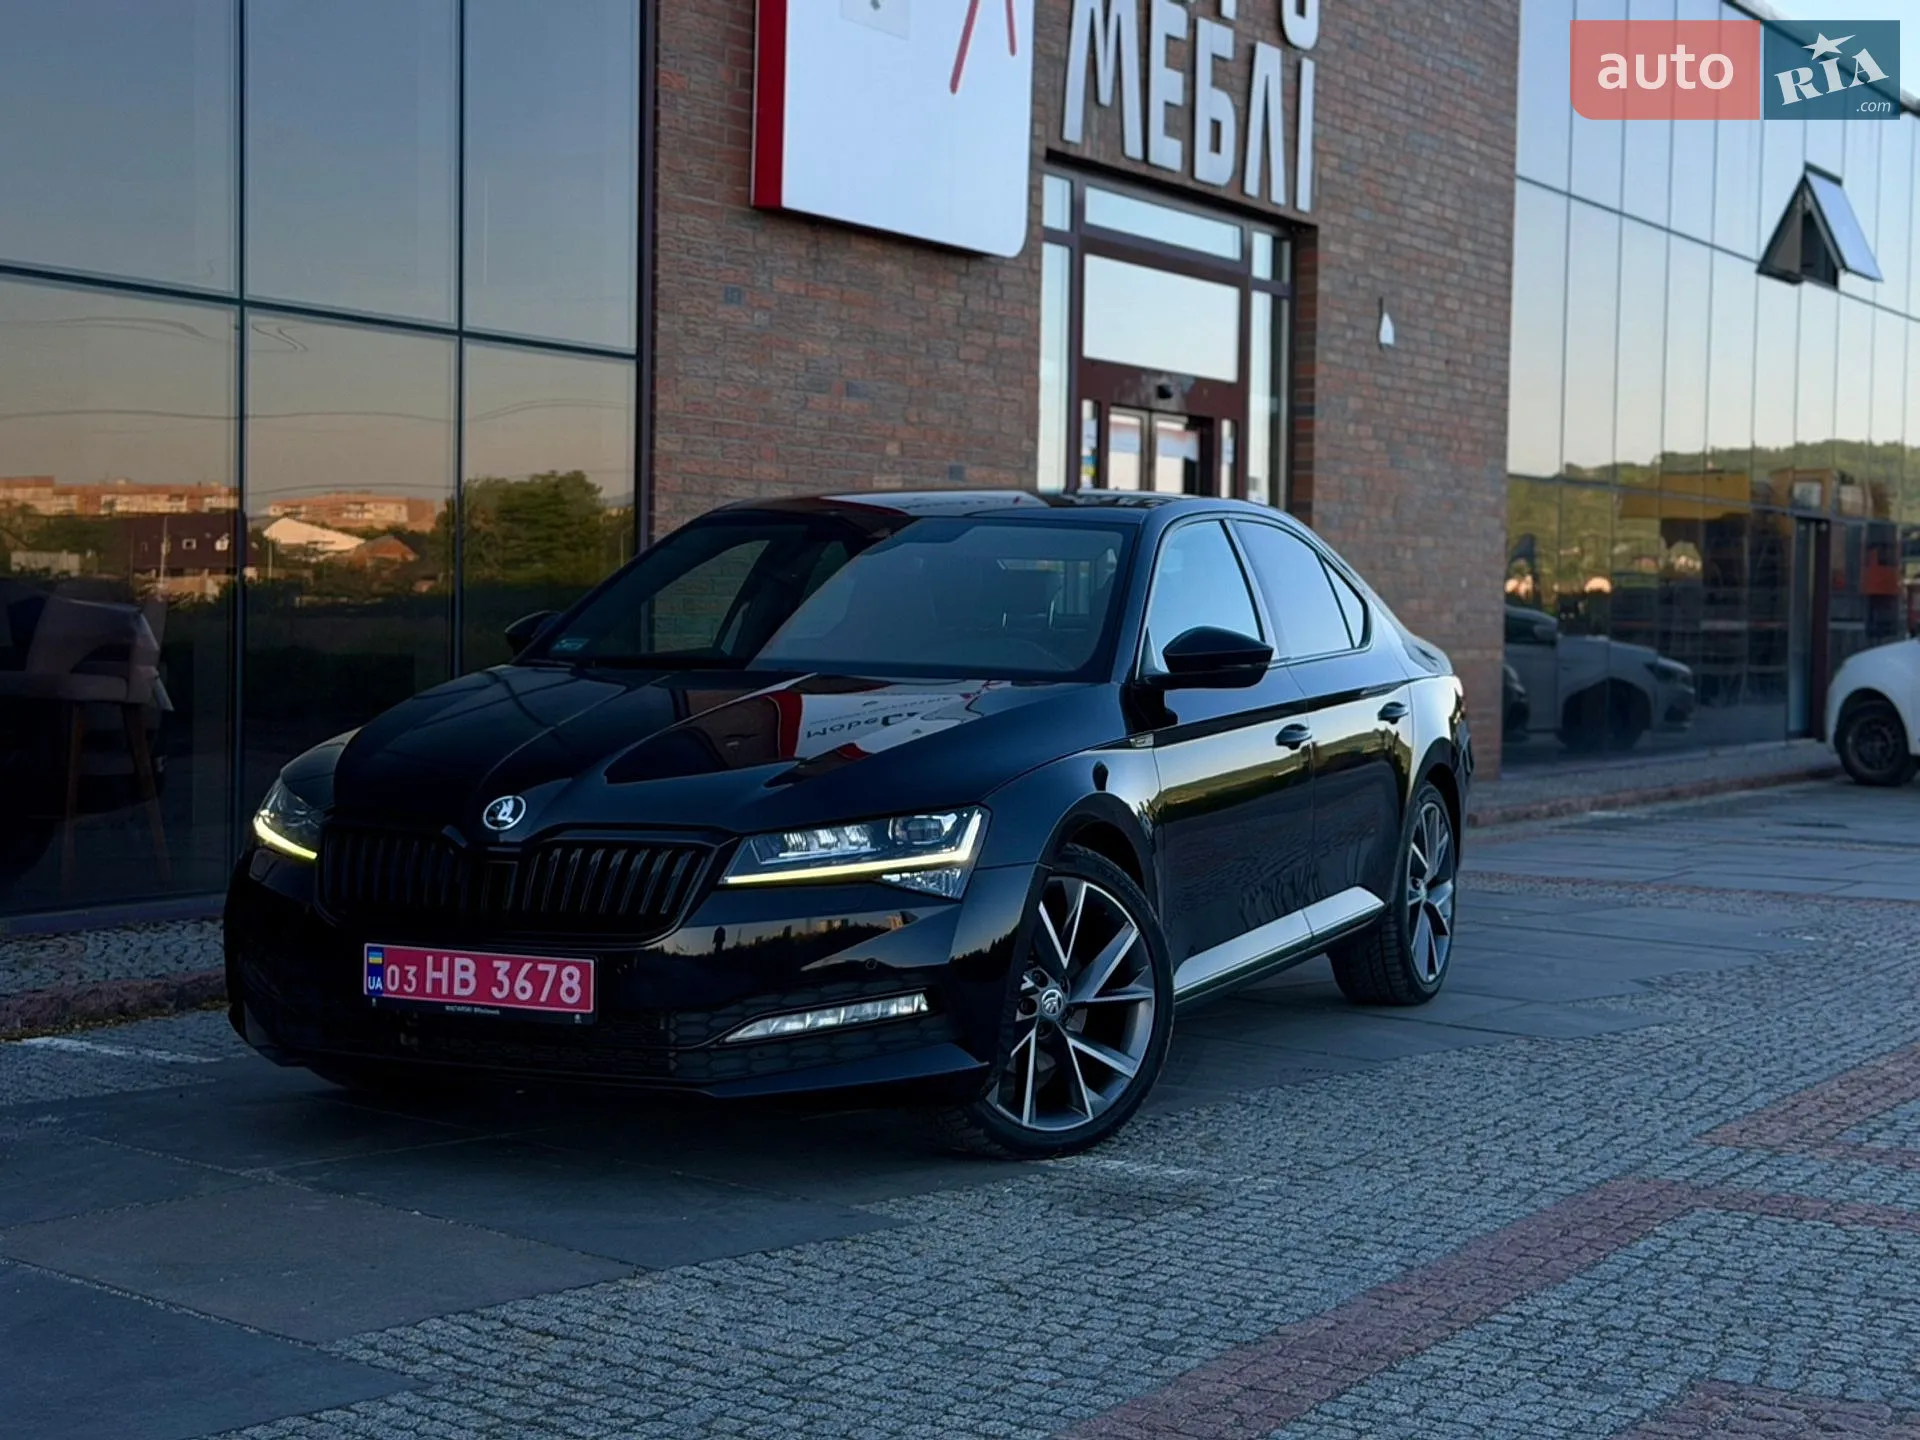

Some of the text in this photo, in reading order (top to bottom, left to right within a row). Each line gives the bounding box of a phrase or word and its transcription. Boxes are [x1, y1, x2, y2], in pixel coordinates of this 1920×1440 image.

[1062, 0, 1316, 213] МЕБЛІ
[367, 975, 383, 991] UA
[386, 955, 582, 1005] 03 HB 3678
